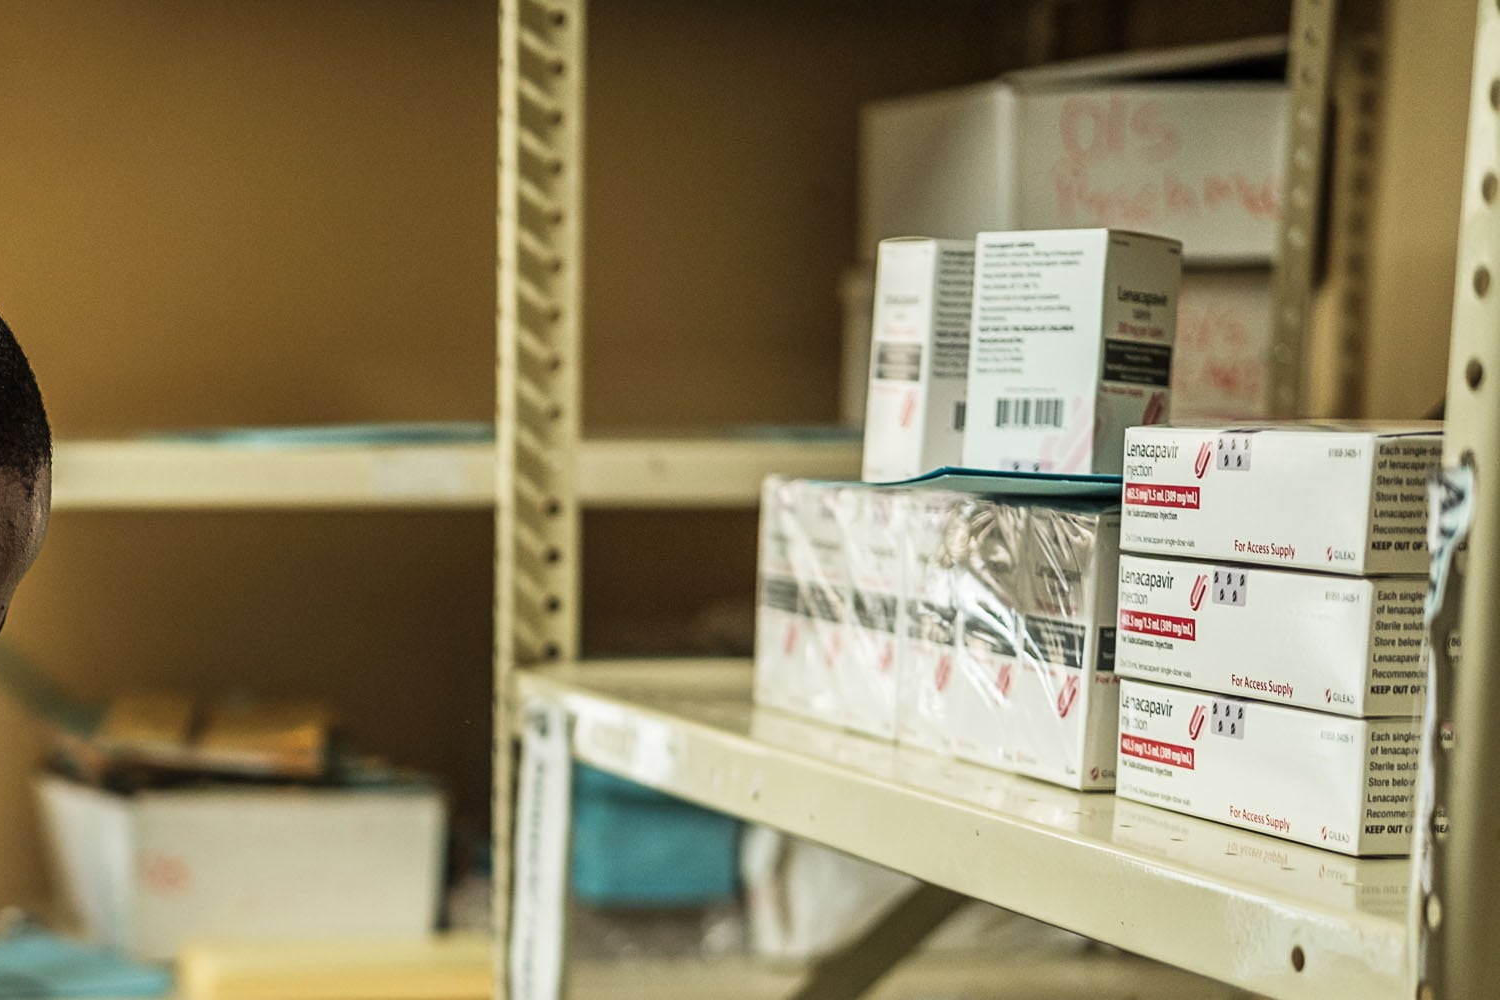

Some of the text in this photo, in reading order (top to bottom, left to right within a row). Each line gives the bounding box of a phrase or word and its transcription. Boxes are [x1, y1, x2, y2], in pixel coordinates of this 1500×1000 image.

[1126, 440, 1179, 462] Lenacapavir
[1406, 477, 1426, 486] solut
[1400, 493, 1424, 502] below
[1374, 509, 1423, 519] Lenacapavir
[1373, 524, 1427, 535] Recommende
[1235, 540, 1295, 559] For Access Supply
[1372, 542, 1423, 551] KEEP OUT OF
[1121, 567, 1174, 591] Lenacapavir
[1378, 591, 1397, 601] Each
[1376, 605, 1385, 615] of
[1374, 637, 1422, 648] Store below
[1373, 653, 1420, 664] Lenacapavir
[1232, 674, 1293, 698] For Access Supply
[1370, 685, 1391, 694] KEEP
[1393, 685, 1408, 694] OUT
[1333, 691, 1355, 704] GILEAD
[1372, 732, 1390, 742] Each
[1370, 746, 1379, 755] of
[1370, 762, 1394, 771] Sterile
[1368, 778, 1389, 787] Store
[1230, 805, 1291, 833] For Access Supply
[1365, 825, 1385, 834] KEEP
[1387, 825, 1403, 834] OUT
